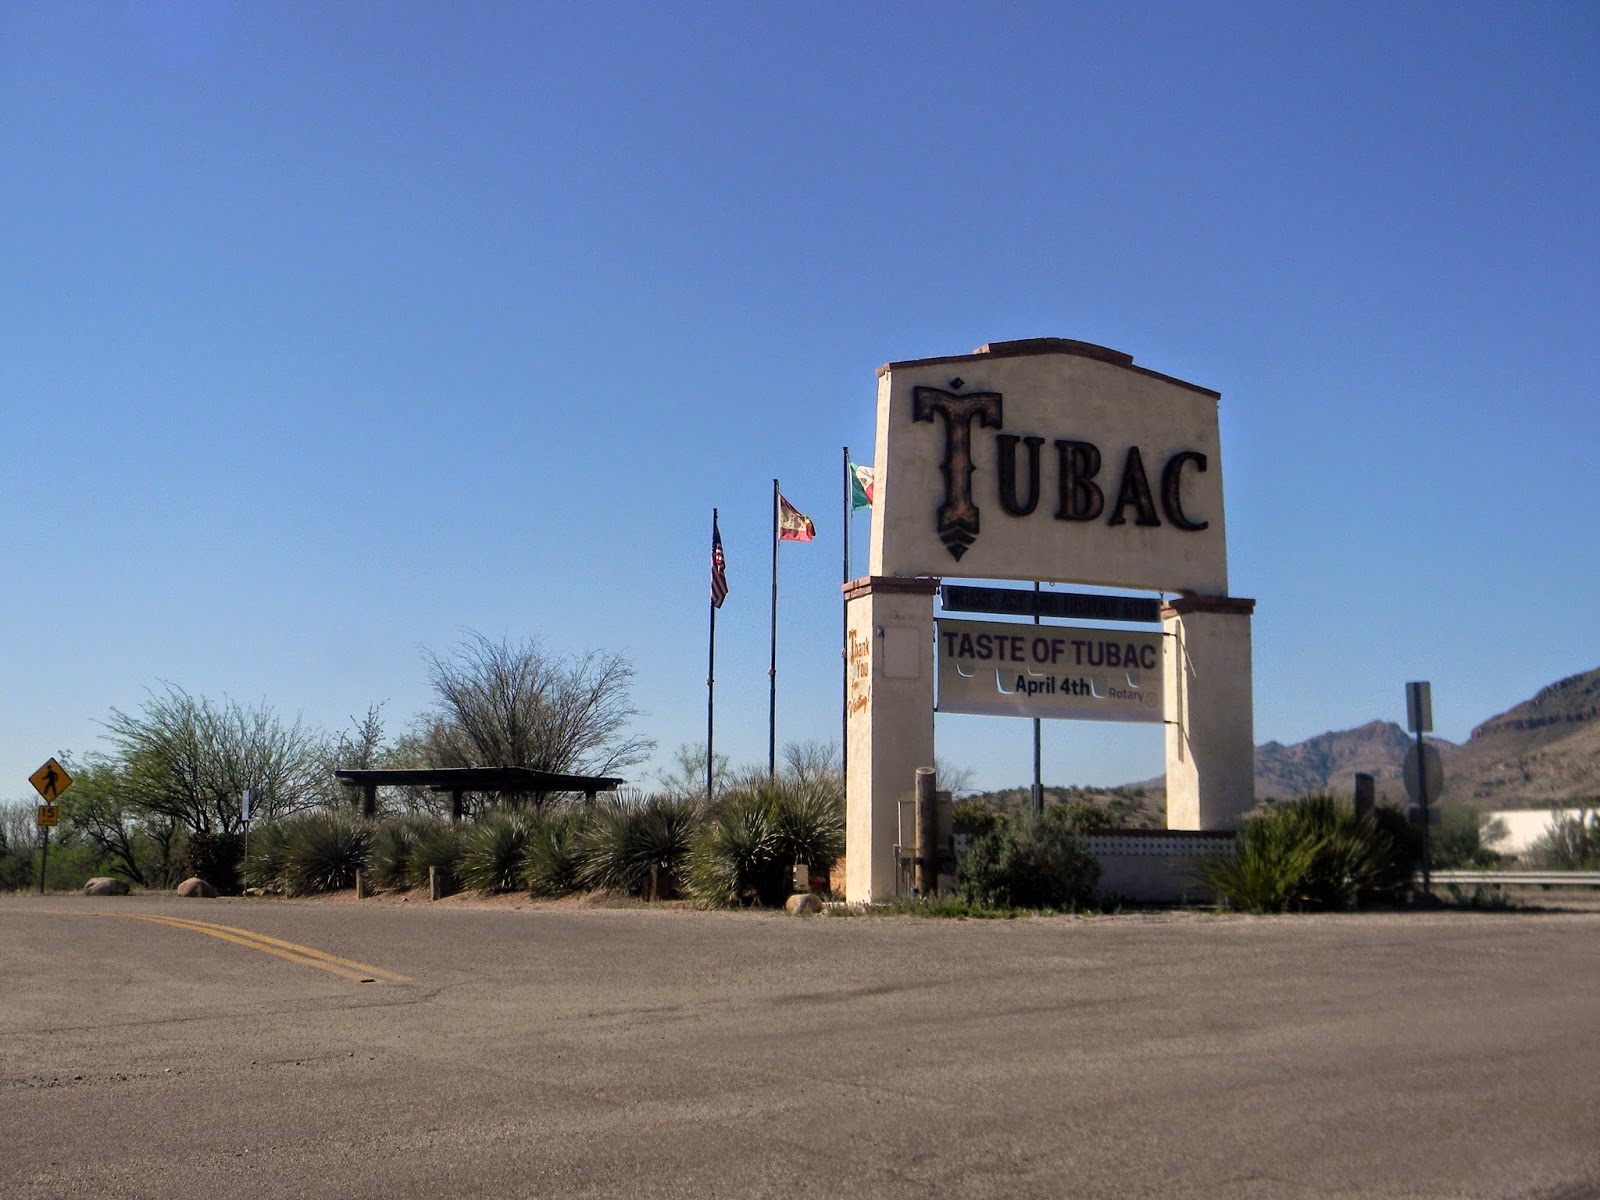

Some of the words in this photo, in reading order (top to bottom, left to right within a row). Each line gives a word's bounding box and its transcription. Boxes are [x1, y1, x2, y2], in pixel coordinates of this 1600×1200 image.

[912, 378, 1208, 562] TUBAC
[849, 629, 869, 665] Thank
[943, 632, 1025, 662] TASTE
[1031, 638, 1066, 664] OF
[1071, 641, 1157, 669] TUBAC
[857, 660, 868, 678] You
[1015, 675, 1055, 696] April
[1060, 676, 1090, 696] 4th
[1109, 687, 1144, 701] Rotary
[42, 808, 55, 818] 15
